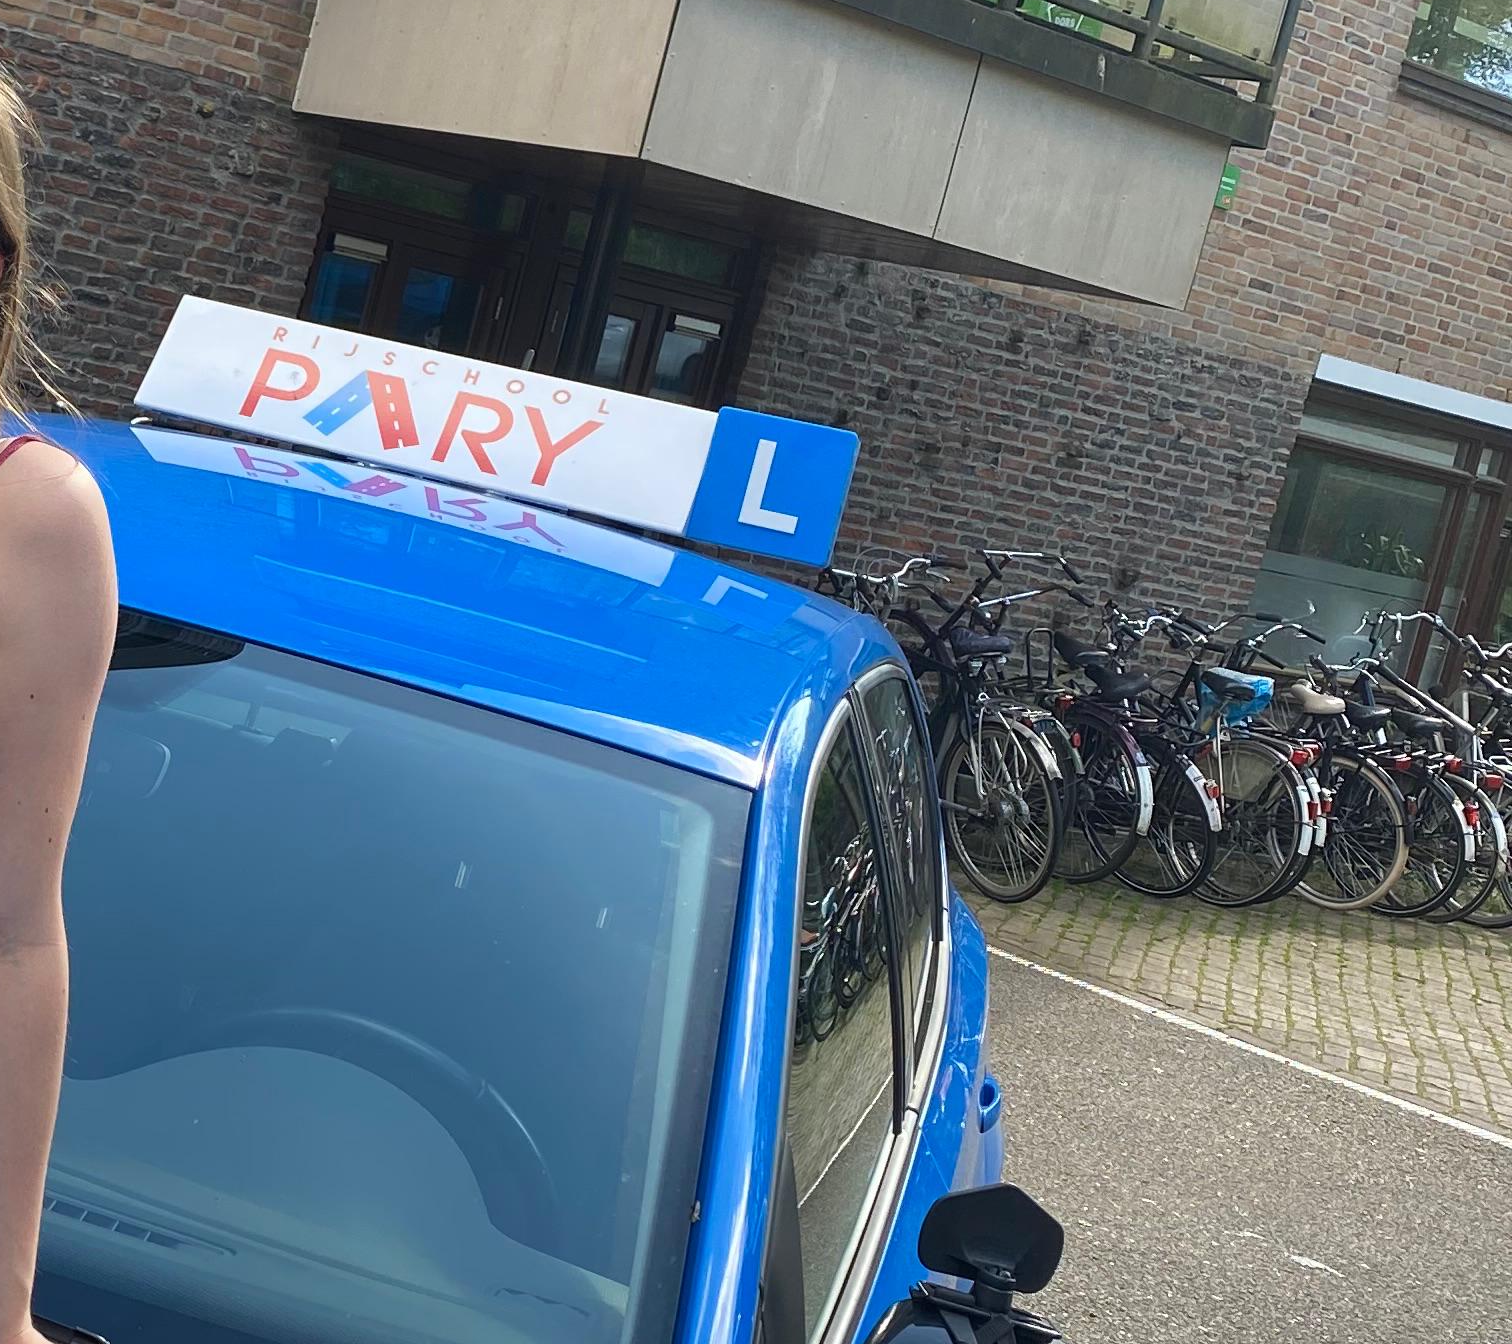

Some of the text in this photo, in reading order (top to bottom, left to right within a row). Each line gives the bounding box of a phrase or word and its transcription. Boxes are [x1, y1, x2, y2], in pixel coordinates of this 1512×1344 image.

[239, 347, 605, 486] PARY
[272, 326, 610, 415] RIJSCHOOL
[738, 439, 798, 534] L
